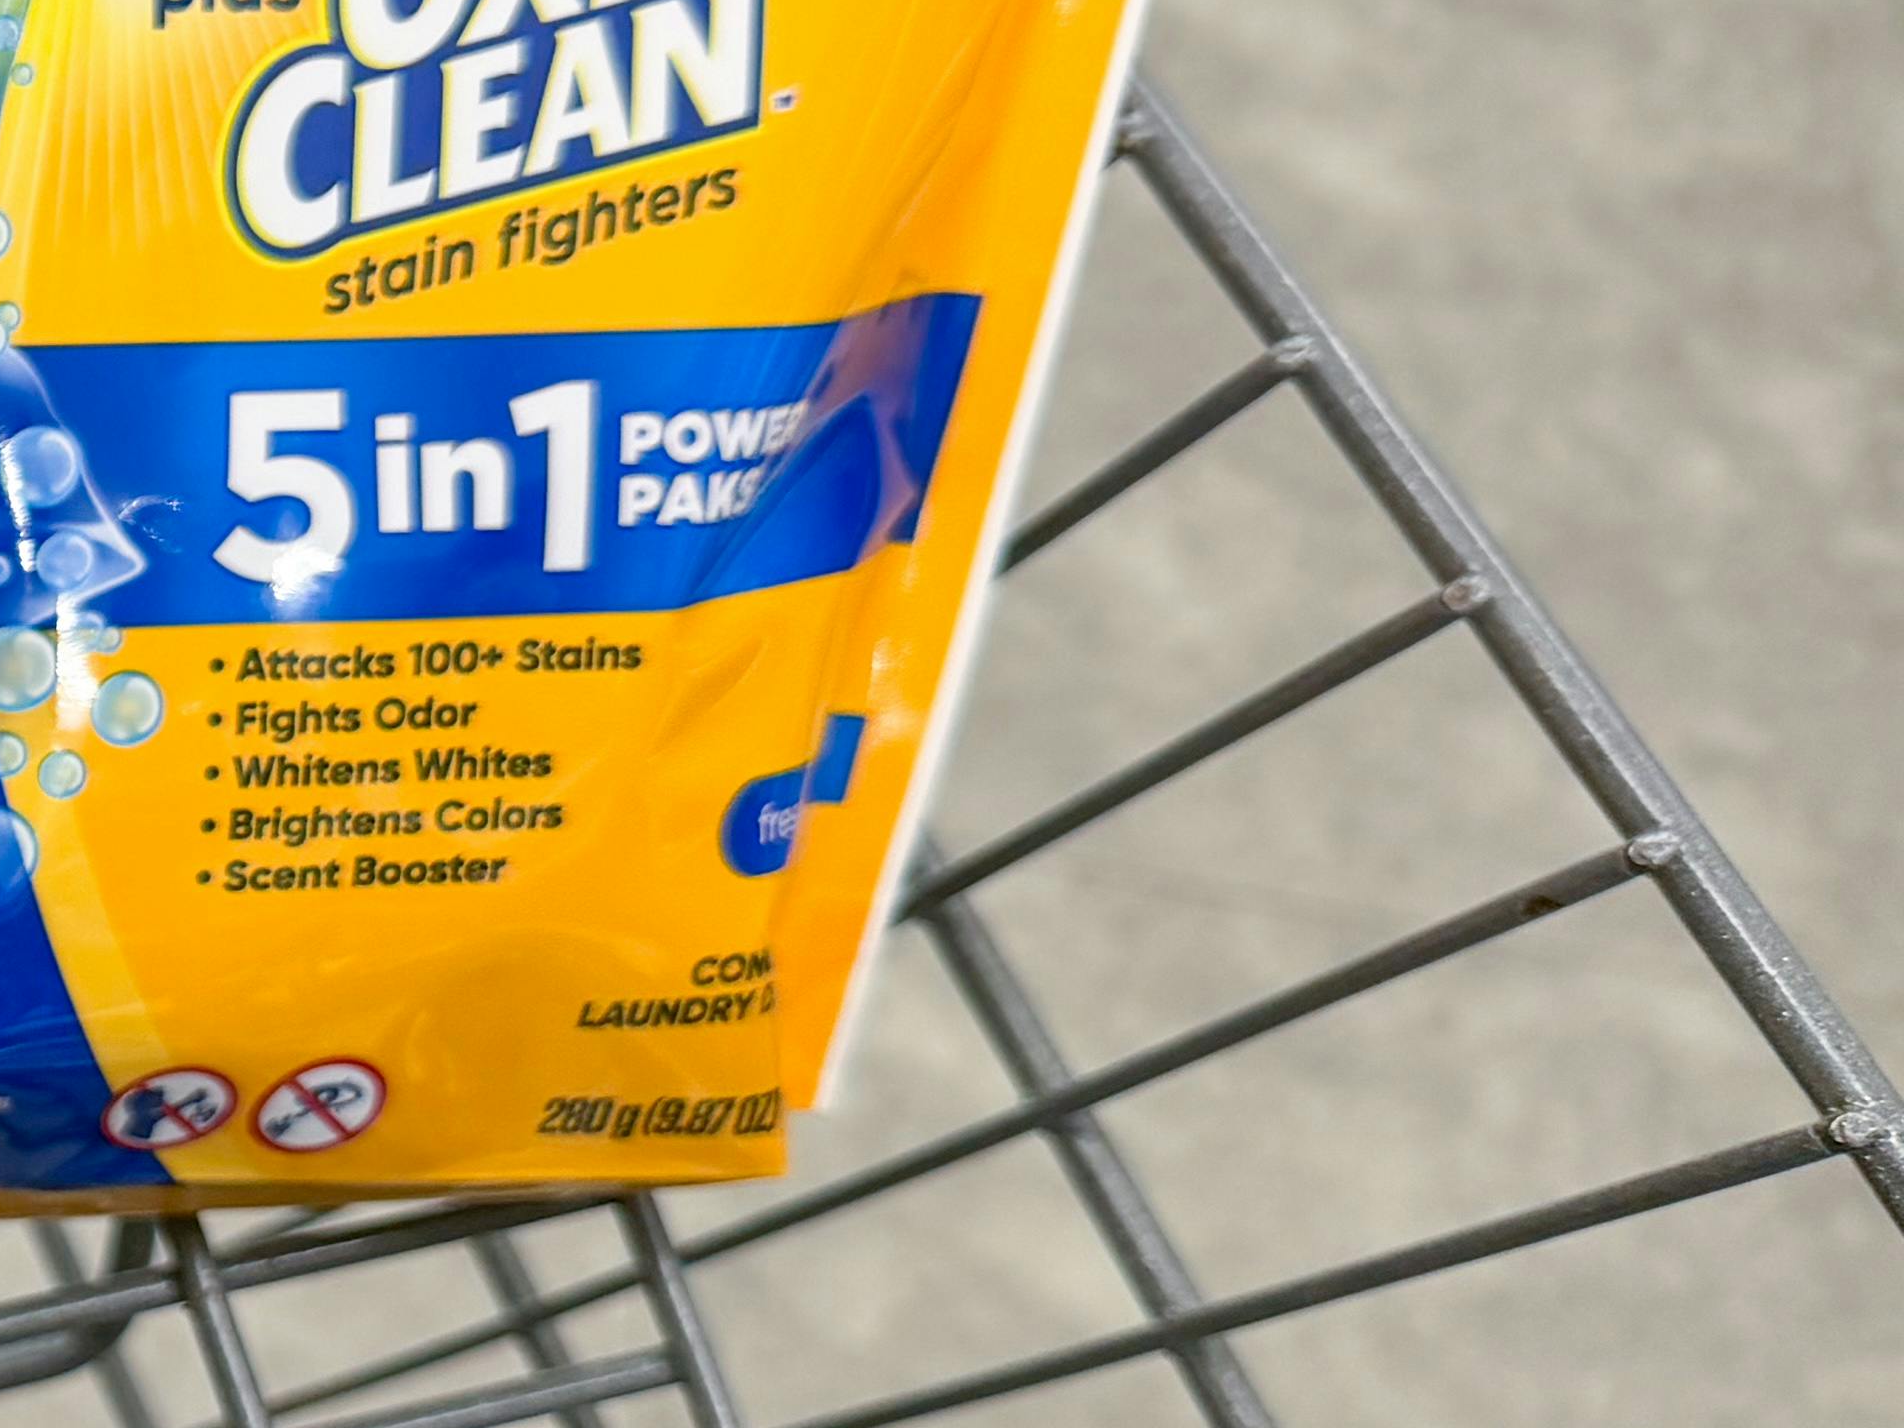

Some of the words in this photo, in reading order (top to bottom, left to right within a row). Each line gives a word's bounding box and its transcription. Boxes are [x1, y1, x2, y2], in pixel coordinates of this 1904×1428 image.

[324, 234, 474, 313] stain
[495, 166, 737, 270] fighters
[234, 647, 395, 682] Attacks
[410, 642, 502, 674] 100+
[517, 638, 641, 673] Stains
[234, 700, 361, 742] Fights
[374, 697, 478, 731] Odor
[233, 752, 400, 789] Whitens
[414, 747, 552, 780] Whites
[229, 805, 421, 847] Brightens
[435, 799, 563, 833] Colors
[223, 857, 339, 892] Scent
[353, 852, 506, 887] Booster
[577, 994, 754, 1028] LAUNDRY
